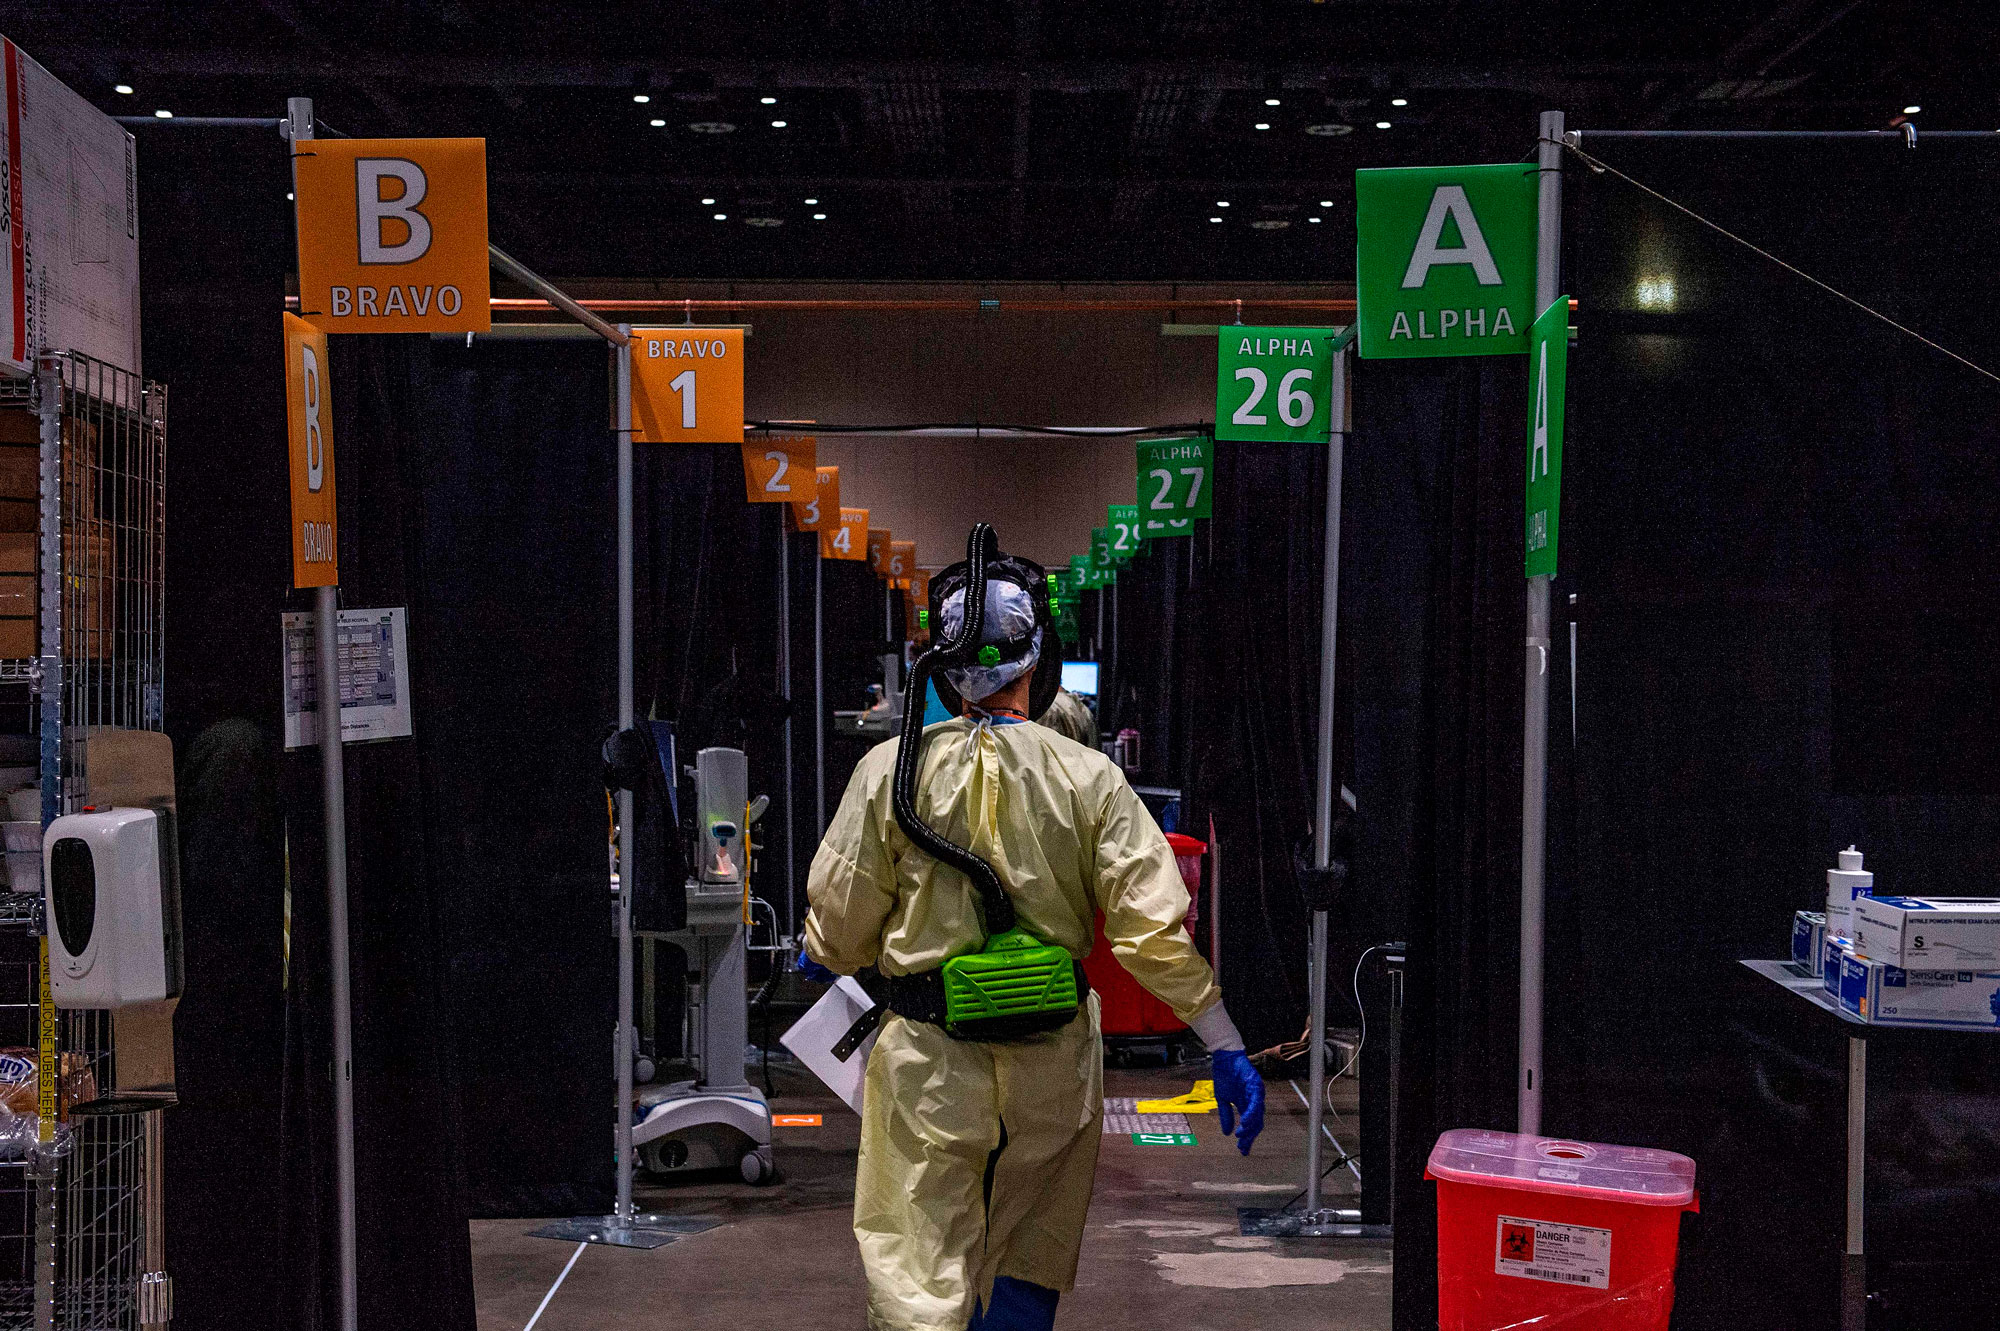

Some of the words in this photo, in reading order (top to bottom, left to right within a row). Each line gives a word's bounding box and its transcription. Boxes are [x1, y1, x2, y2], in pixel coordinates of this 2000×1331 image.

[12, 155, 24, 250] Classic
[355, 157, 433, 266] B
[1401, 184, 1504, 289] A
[25, 231, 33, 288] CUPS
[330, 285, 463, 317] BRAVO
[1389, 307, 1516, 340] ALPHA
[648, 339, 726, 359] BRAVO
[1238, 338, 1314, 357] ALPHA
[669, 370, 697, 429] 1
[1232, 367, 1315, 428] 26
[1531, 340, 1548, 483] A
[303, 345, 323, 493] B
[764, 451, 791, 492] 2
[1150, 446, 1203, 460] ALPHA
[1149, 467, 1205, 510] 27
[303, 522, 333, 563] BRAVO
[833, 527, 852, 554] 4
[890, 555, 904, 577] 6
[1076, 567, 1086, 586] 3
[1914, 936, 1924, 948] S
[42, 991, 53, 1044] SILICONE
[1882, 1006, 1898, 1014] 250
[42, 1049, 53, 1087] TUBES
[1536, 1230, 1570, 1243] DANGER
